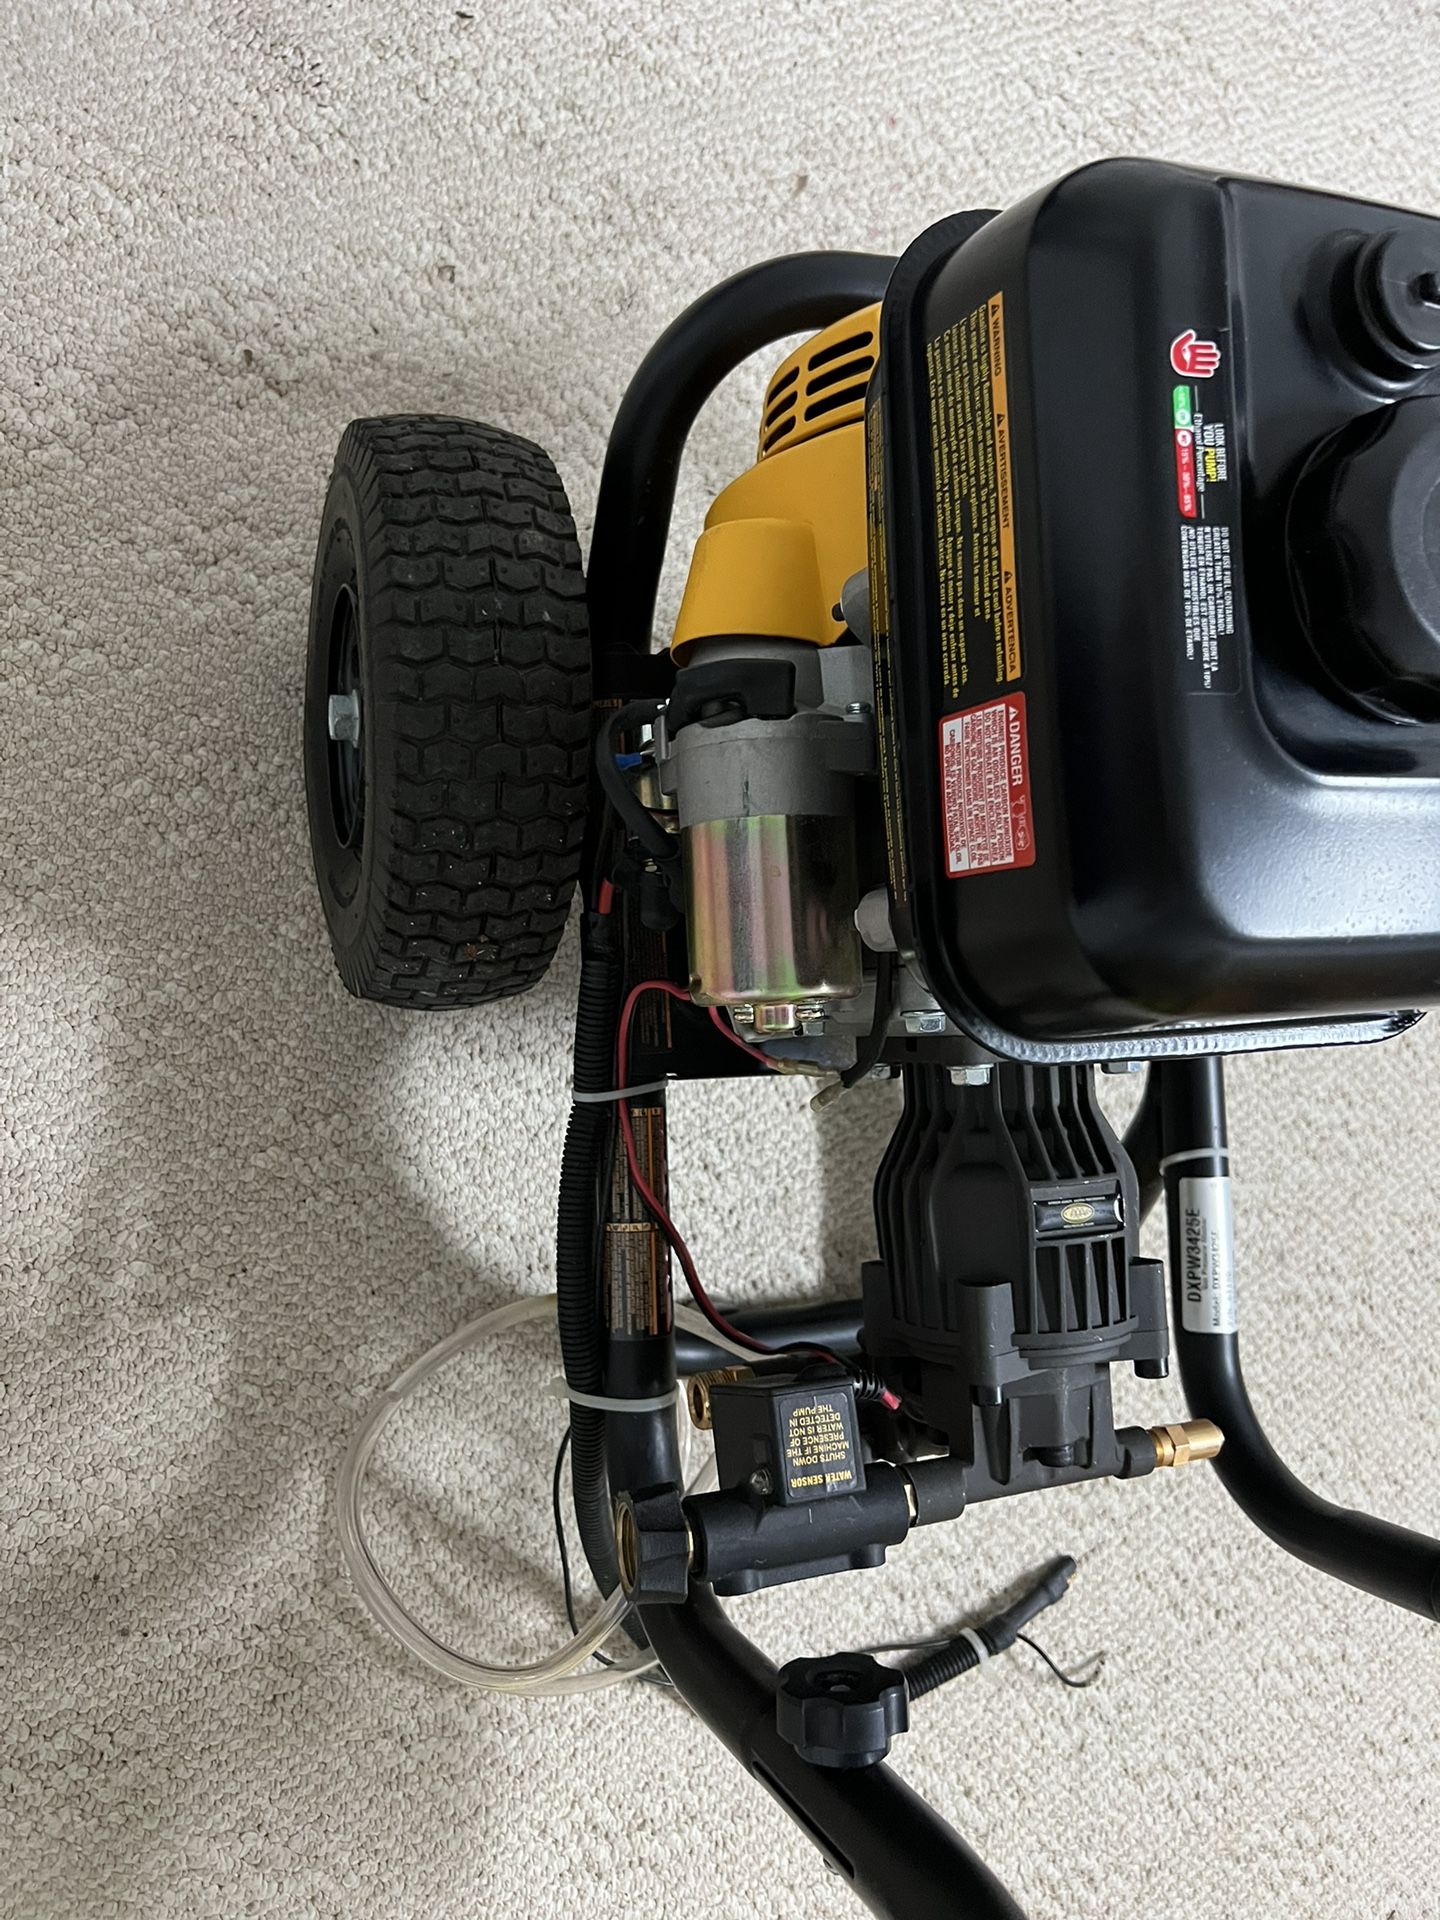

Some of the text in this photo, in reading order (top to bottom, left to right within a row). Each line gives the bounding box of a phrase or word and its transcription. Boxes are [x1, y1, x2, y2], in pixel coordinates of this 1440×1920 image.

[1194, 413, 1206, 492] Ethanol Percentage
[1204, 425, 1217, 482] YOU PUMP!
[1214, 423, 1227, 481] LOOK BEFORE
[992, 319, 1016, 672] WARNING AVERTISSEMENT ADVERTENCIA
[1221, 527, 1229, 537] DO
[1213, 527, 1222, 559] GREATER
[1222, 539, 1230, 553] NOT
[1206, 568, 1214, 582] PAS
[1215, 562, 1223, 580] THAN
[1223, 572, 1231, 588] FUEL
[1207, 584, 1214, 593] UN
[1208, 596, 1216, 639] CARBURANT
[1224, 591, 1234, 634] CONTAINING
[1211, 662, 1218, 671] LA
[1009, 722, 1023, 785] DANGER
[1186, 1208, 1201, 1303] DXPW3425E
[792, 1404, 833, 1416] THE PUMP
[789, 1412, 840, 1427] DETECTED IN
[789, 1422, 844, 1437] WATER IS NOT
[789, 1432, 844, 1447] PRESENCE OF
[786, 1441, 849, 1457] MACHINE IF THE
[792, 1451, 846, 1466] SHUTS DOWN
[790, 1470, 852, 1488] WATER SENSOR
